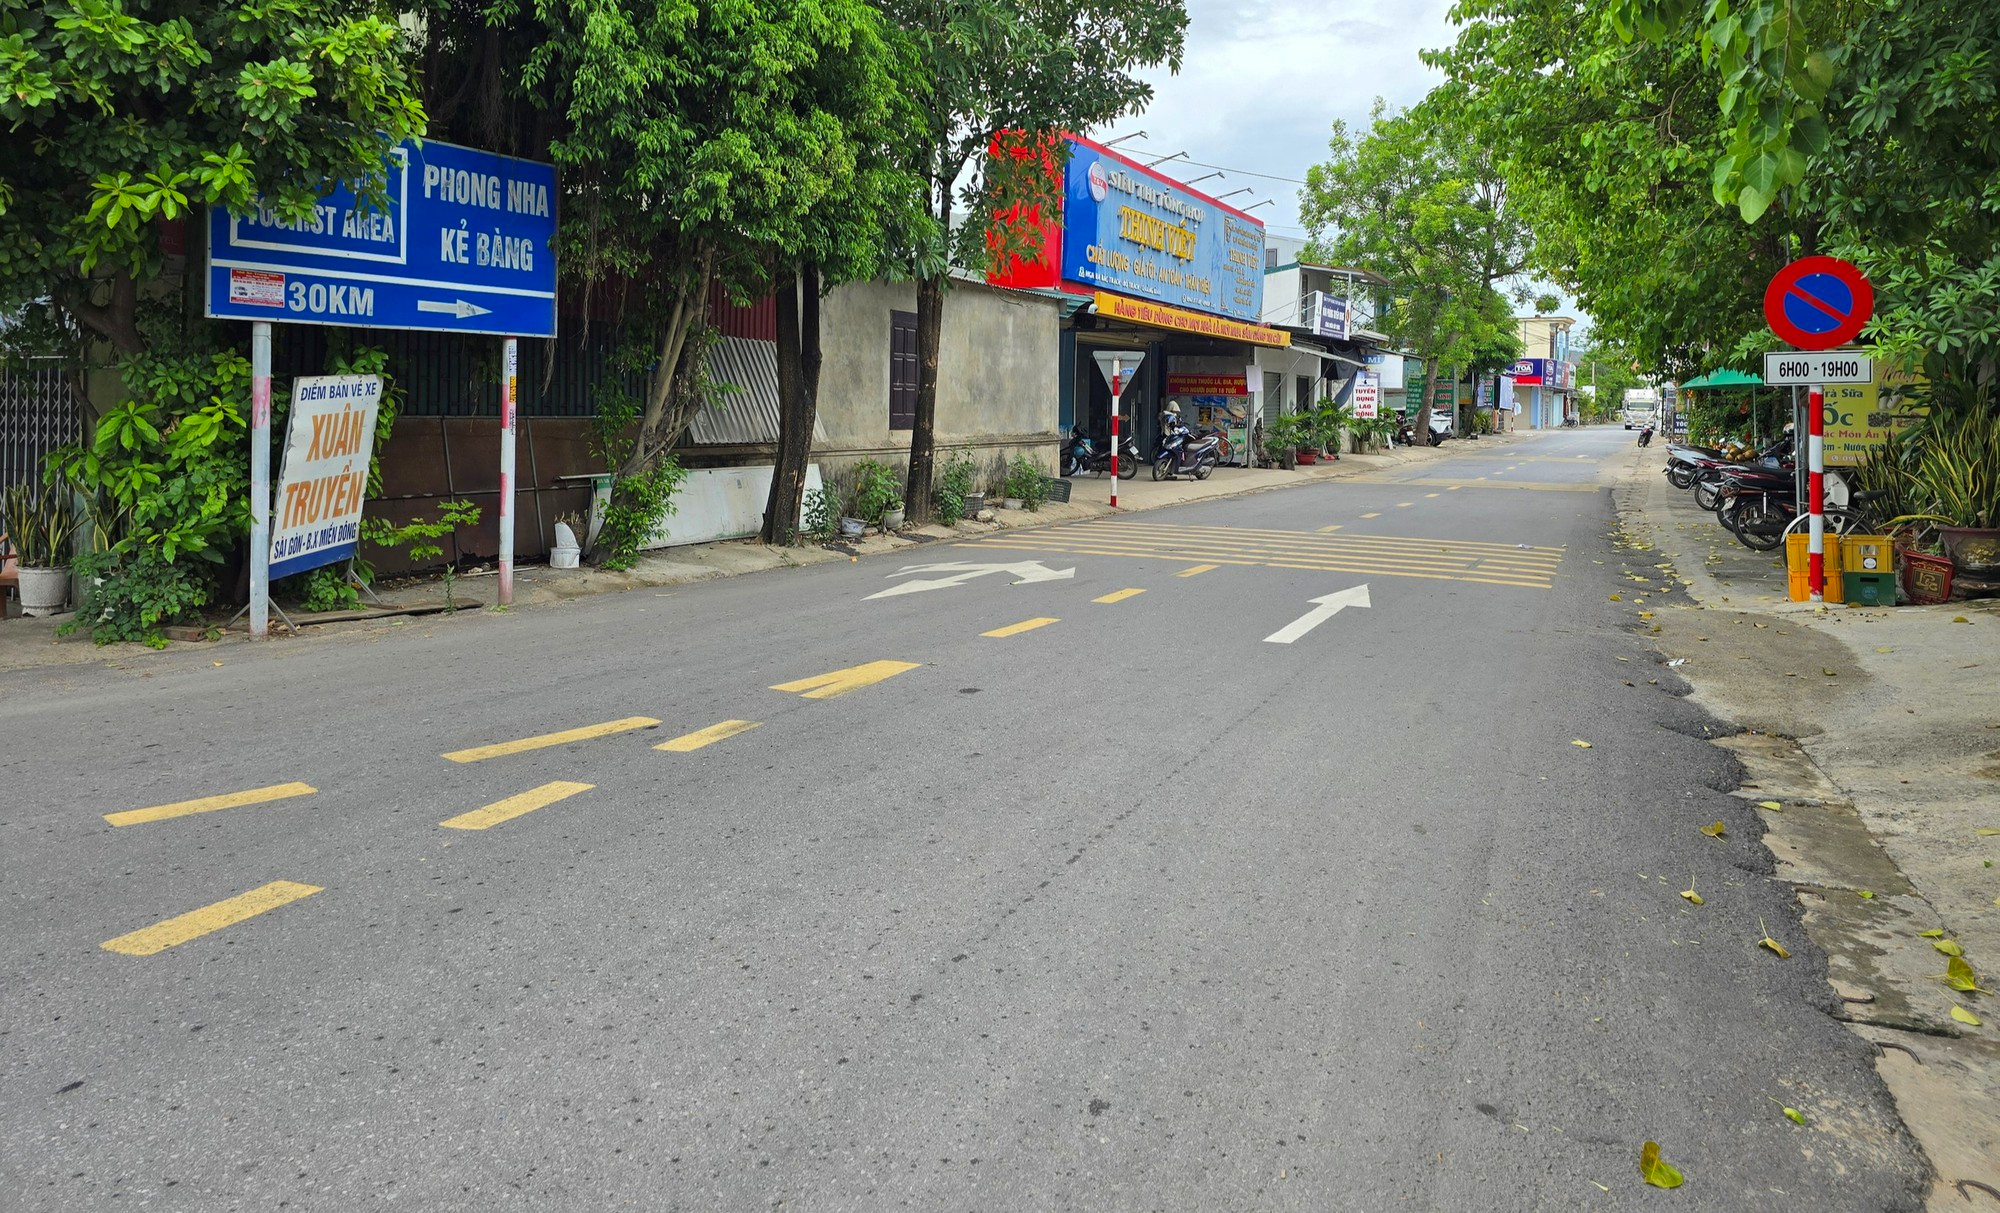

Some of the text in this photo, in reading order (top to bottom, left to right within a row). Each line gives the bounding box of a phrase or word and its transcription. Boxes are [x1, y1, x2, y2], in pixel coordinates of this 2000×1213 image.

[424, 164, 500, 210] PHONG
[507, 179, 549, 217] NHA
[1108, 170, 1135, 195] SIÊU
[1136, 184, 1156, 208] THỊ
[342, 209, 395, 243] AREA
[1118, 205, 1196, 265] THỊNH VIỆT
[441, 218, 534, 271] KẺ BÀNG
[1086, 239, 1104, 266] CHẤT
[1106, 250, 1129, 273] LƯỢNG
[288, 281, 374, 316] 30KM
[1114, 299, 1136, 317] HÀNG
[1138, 306, 1153, 321] TIÊU
[1154, 308, 1173, 326] DÙNG
[1174, 315, 1188, 328] CHO
[1779, 362, 1809, 377] 6H00
[1821, 361, 1858, 377] 19H00
[300, 379, 377, 400] ĐIỂM BÁN VÉ XE
[1823, 388, 1863, 398] rà Sữa
[306, 403, 366, 462] XUÂN
[1823, 430, 1834, 438] ác
[274, 536, 287, 559] SÀI
[288, 532, 303, 555] GÒN
[338, 520, 356, 542] ĐÔNG
